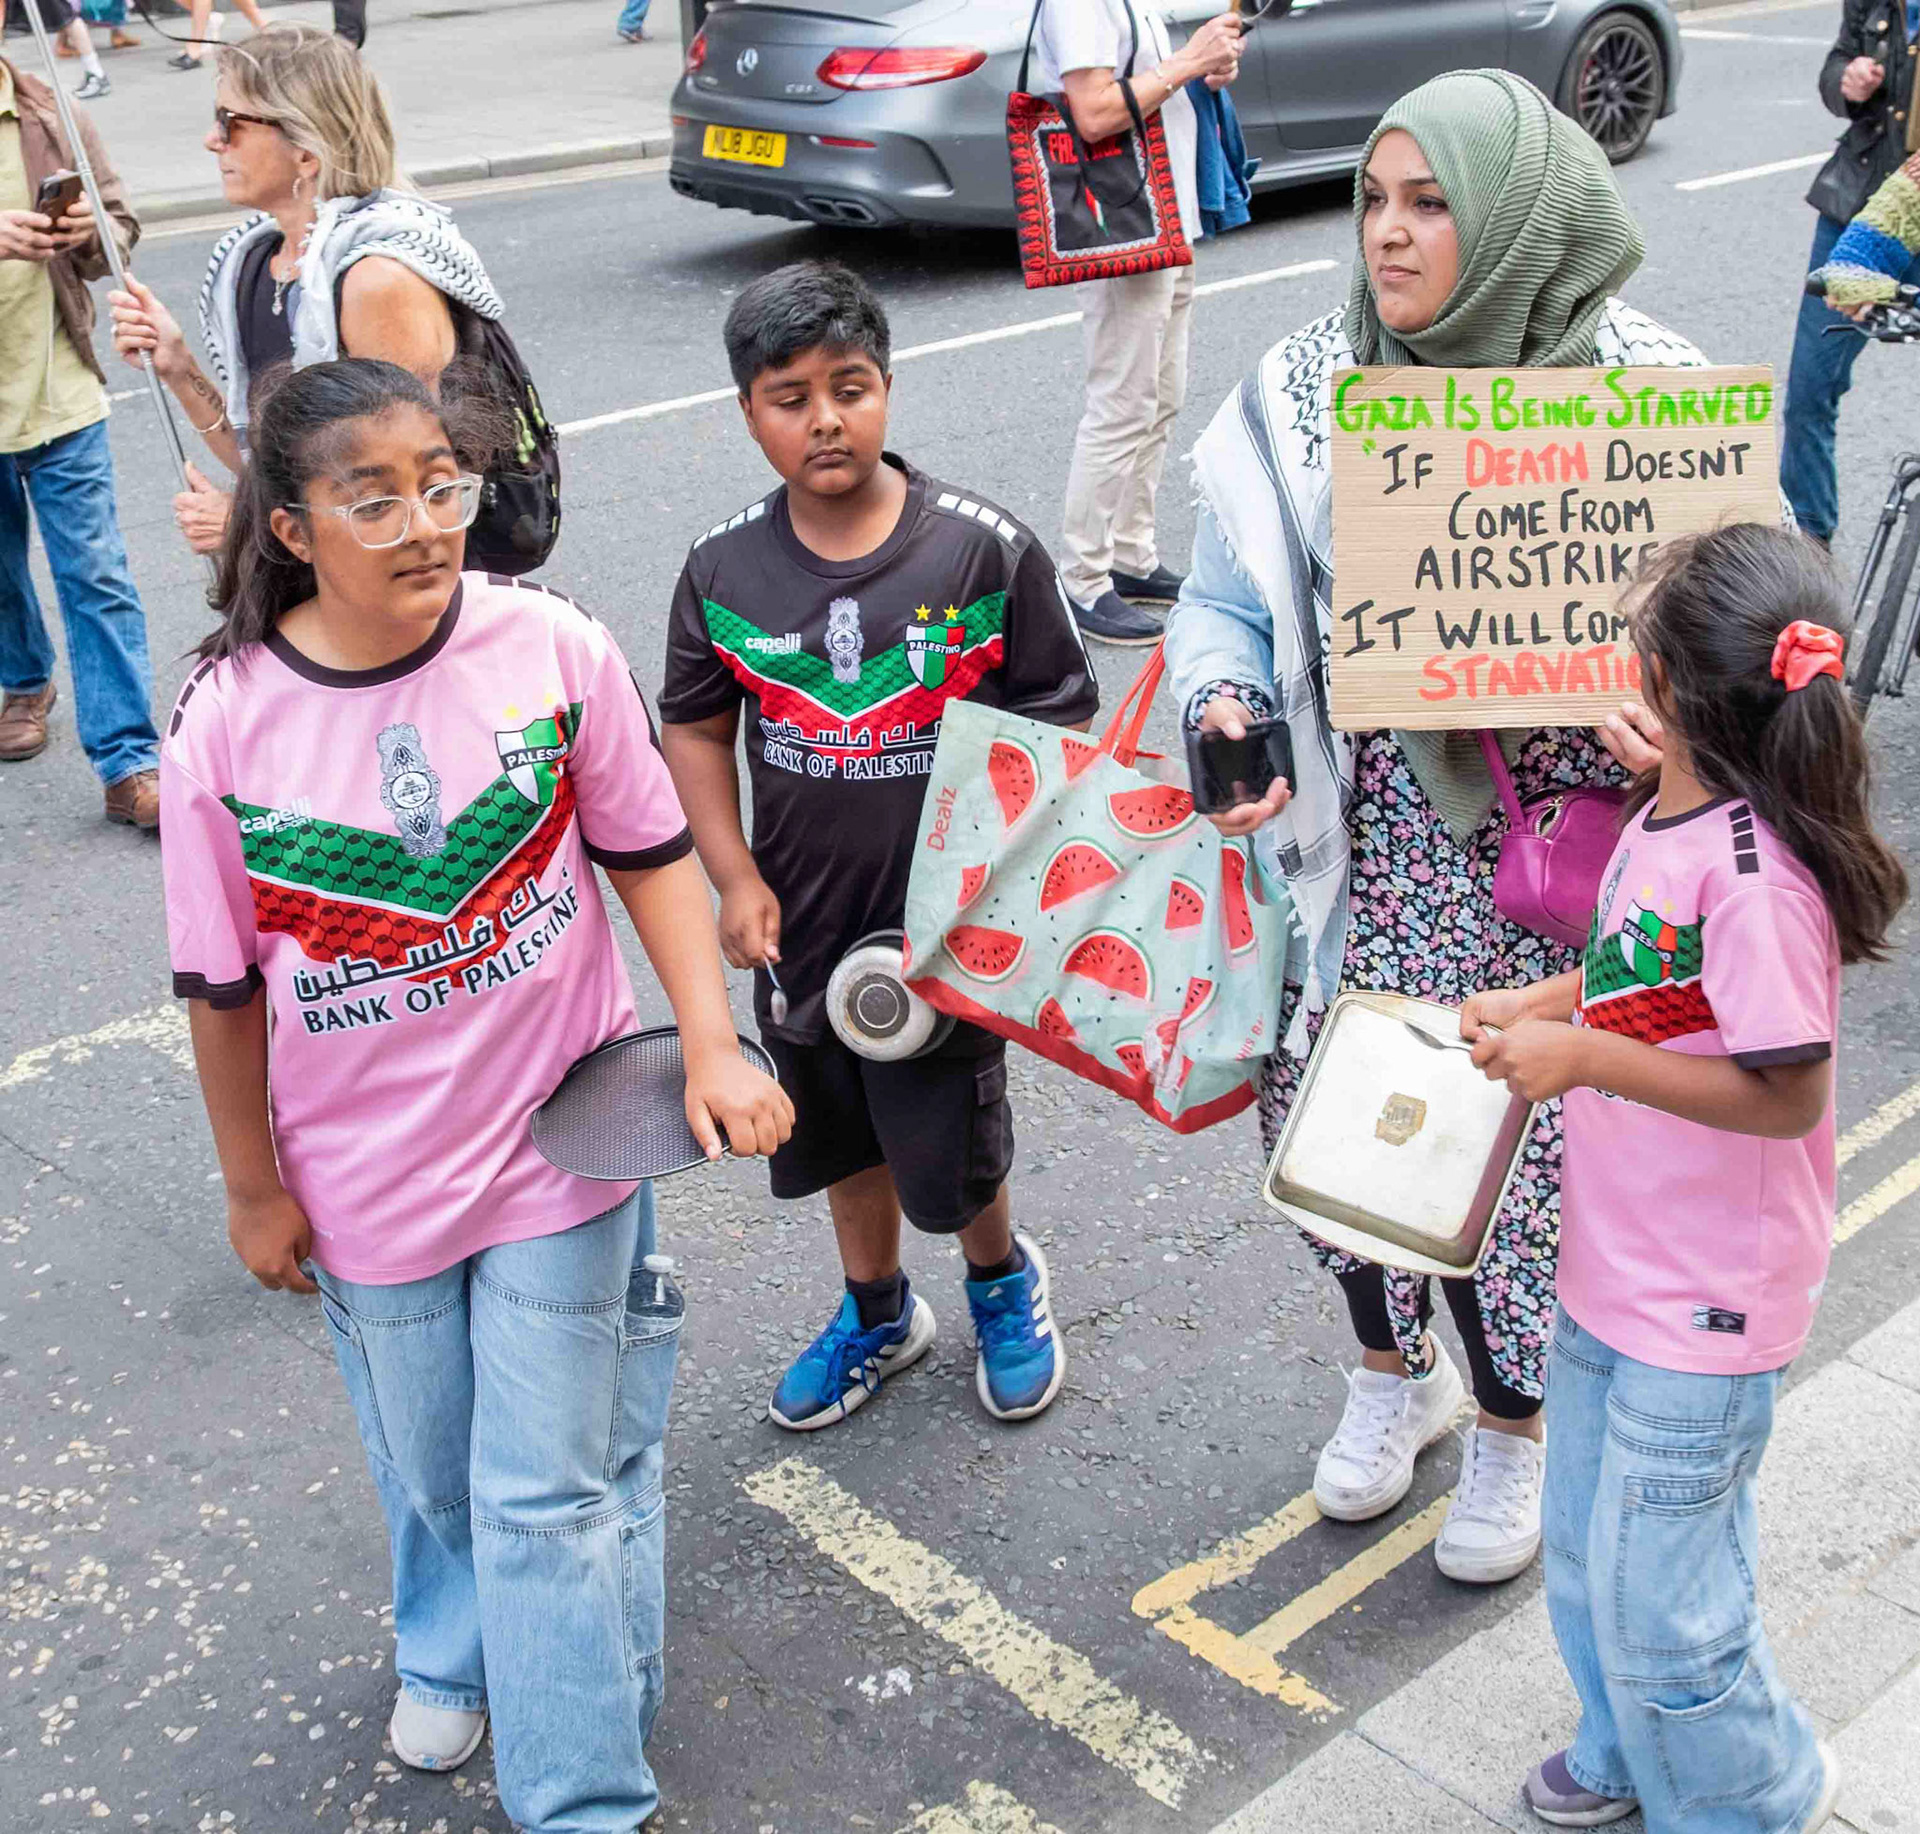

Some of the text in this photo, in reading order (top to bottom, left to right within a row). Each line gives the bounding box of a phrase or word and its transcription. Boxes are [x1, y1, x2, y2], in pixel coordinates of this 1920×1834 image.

[746, 133, 776, 158] JGU
[1336, 369, 1772, 432] GAZA IS BEING STARVED
[1383, 443, 1433, 495] IF
[1466, 438, 1589, 488] DEATH
[1448, 488, 1655, 541] COME FROM
[745, 632, 801, 653] capelli
[909, 641, 961, 655] PALESTINO
[1341, 599, 1629, 658] IT WILL COM
[1418, 643, 1642, 701] STARVATIO
[764, 740, 936, 780] BANK OF PALESTIN
[240, 796, 311, 833] capelli
[927, 785, 957, 852] Dealz
[293, 917, 495, 1002] فلسطين
[303, 994, 396, 1033] BANK
[405, 978, 453, 1013] OF
